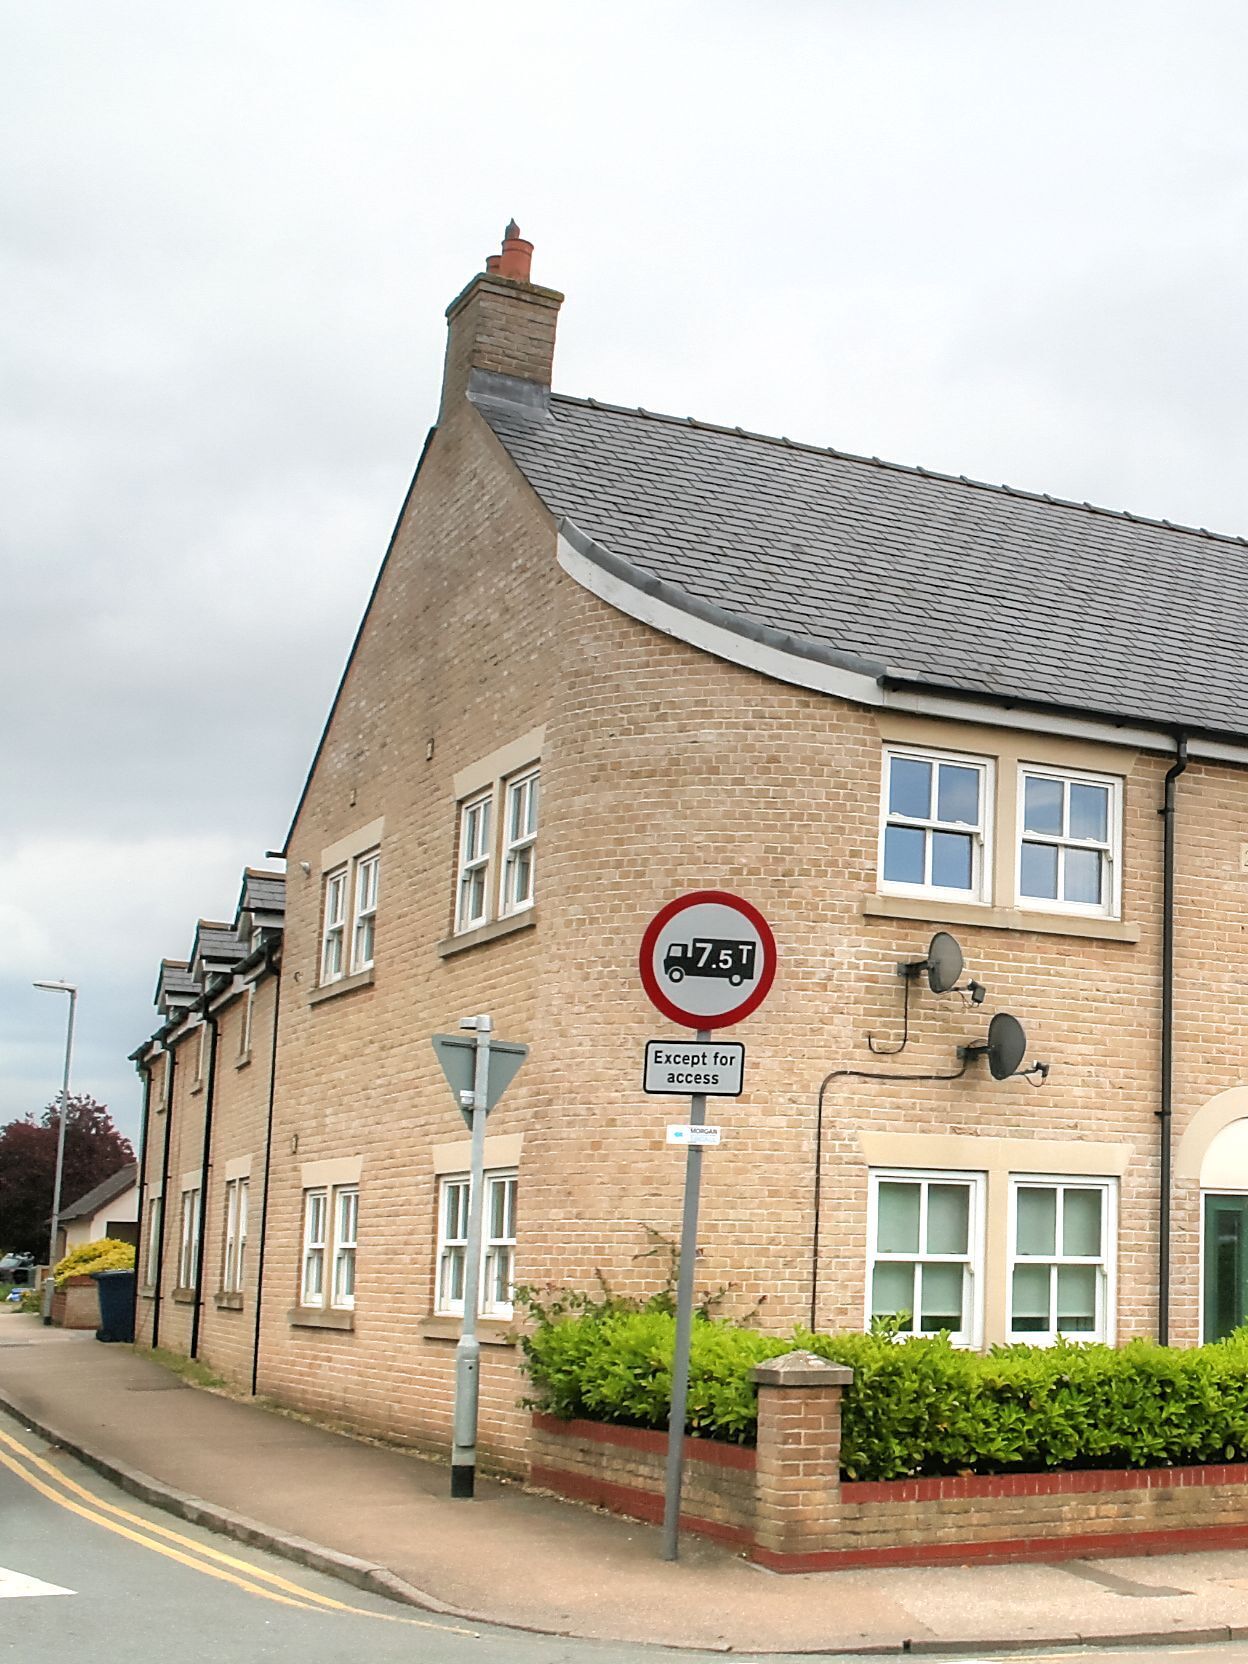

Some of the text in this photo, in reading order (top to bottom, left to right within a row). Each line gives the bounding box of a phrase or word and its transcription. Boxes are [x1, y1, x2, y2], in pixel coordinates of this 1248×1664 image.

[654, 1050, 736, 1068] Except for
[667, 1072, 719, 1085] access
